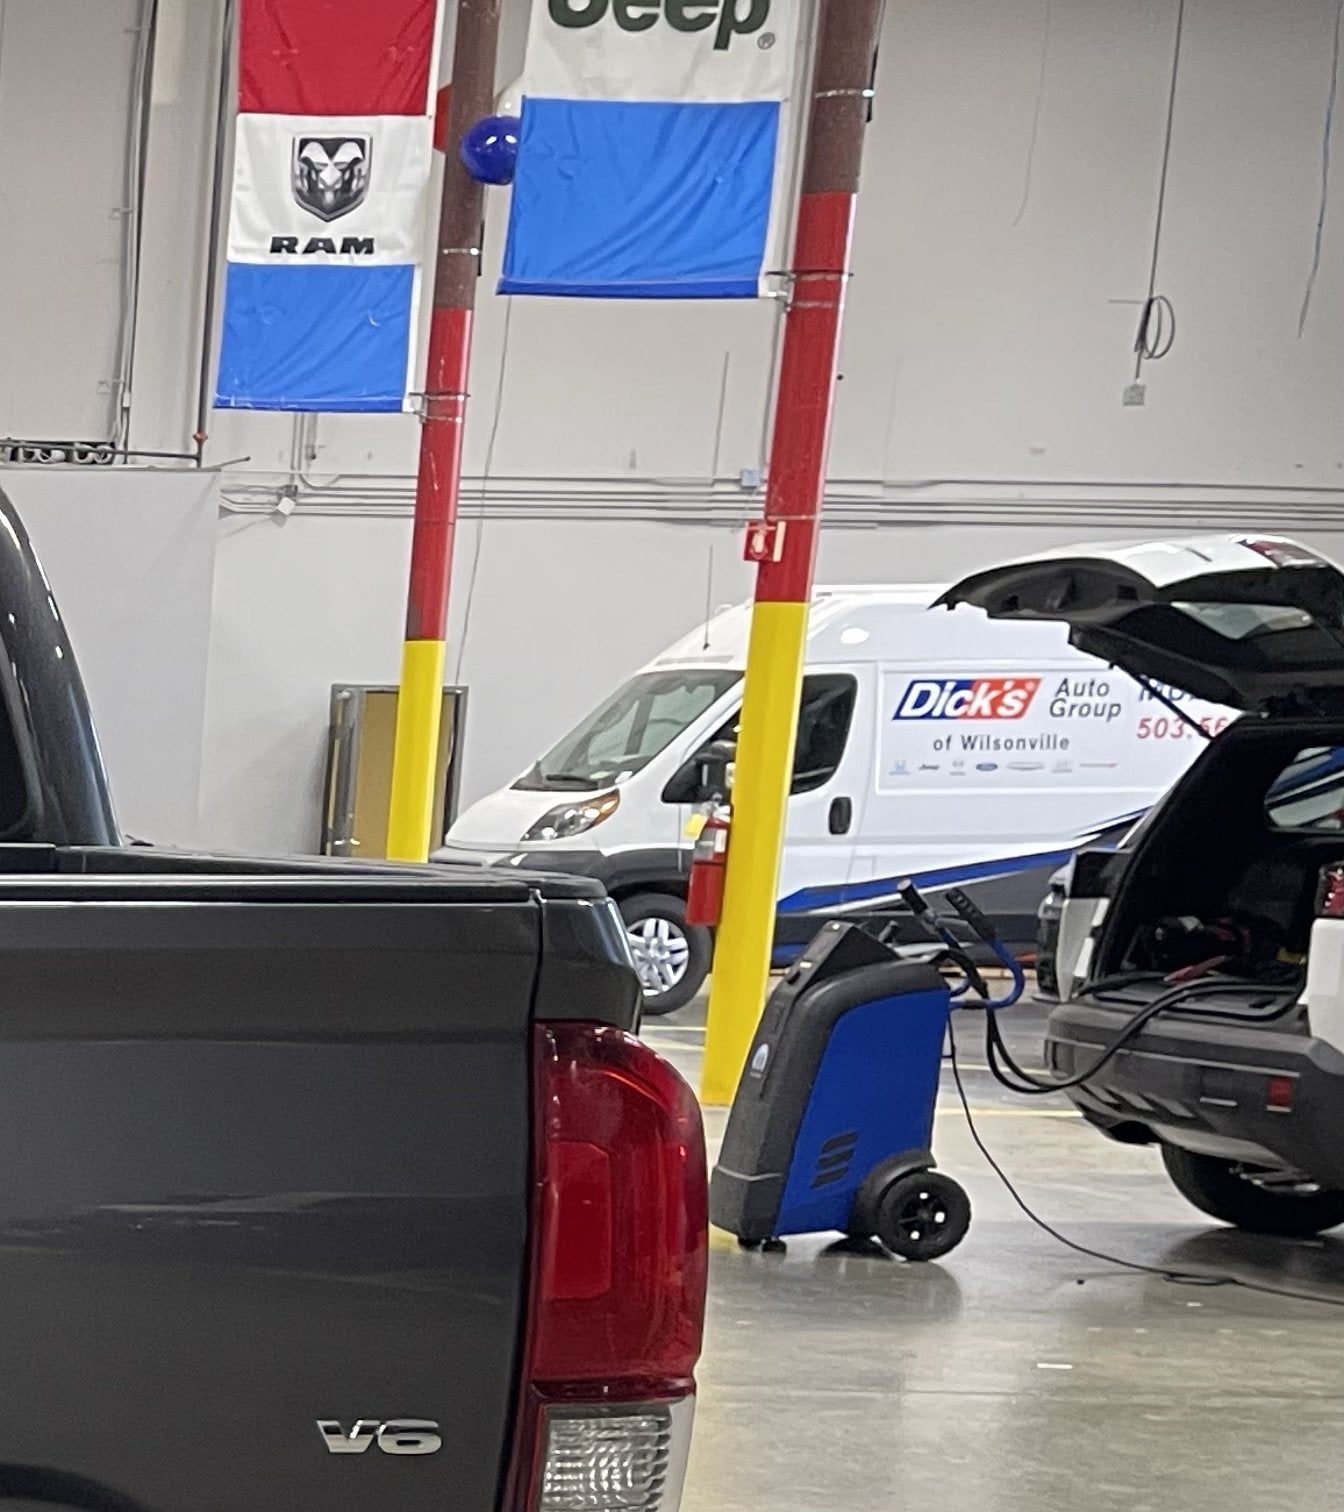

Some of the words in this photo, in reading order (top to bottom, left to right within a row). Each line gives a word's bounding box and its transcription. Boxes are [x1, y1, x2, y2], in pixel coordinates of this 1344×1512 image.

[269, 235, 375, 256] RAM
[1054, 678, 1110, 697] Auto
[898, 682, 1030, 717] Dick's
[1049, 701, 1122, 723] Group
[933, 734, 953, 752] of
[962, 733, 1070, 751] Wilsonville
[316, 1418, 443, 1455] V6
